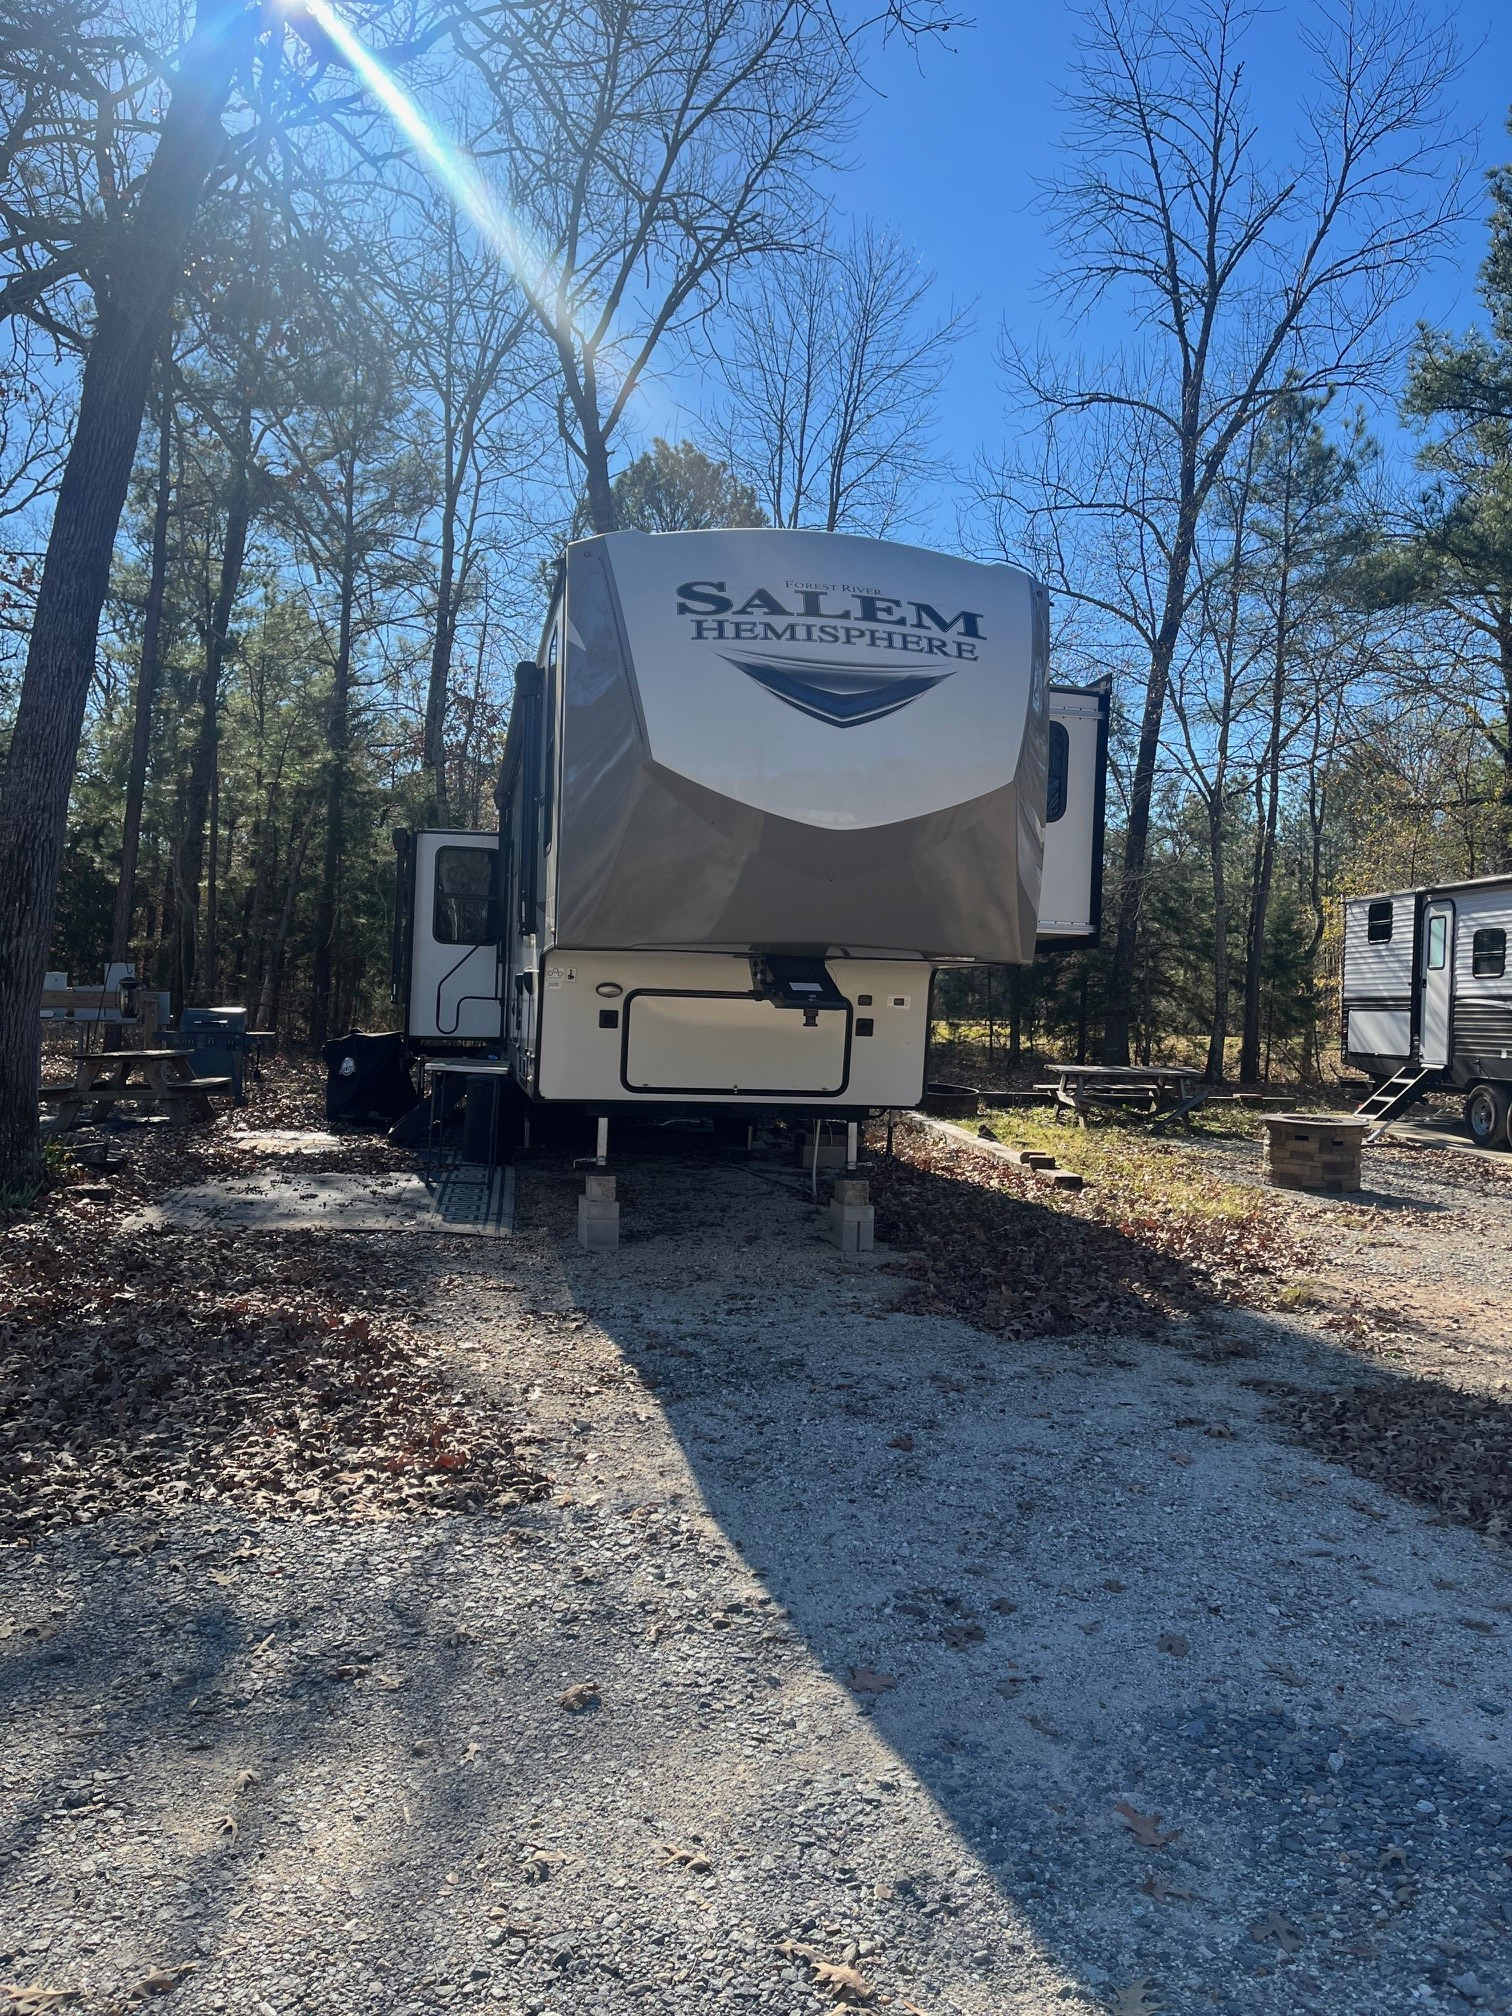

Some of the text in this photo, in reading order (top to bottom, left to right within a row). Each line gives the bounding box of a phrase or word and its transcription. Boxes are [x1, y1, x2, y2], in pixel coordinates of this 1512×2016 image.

[785, 580, 881, 595] FOREST RIVER
[676, 581, 988, 640] SALEM
[690, 619, 979, 661] HEMISPHERE
